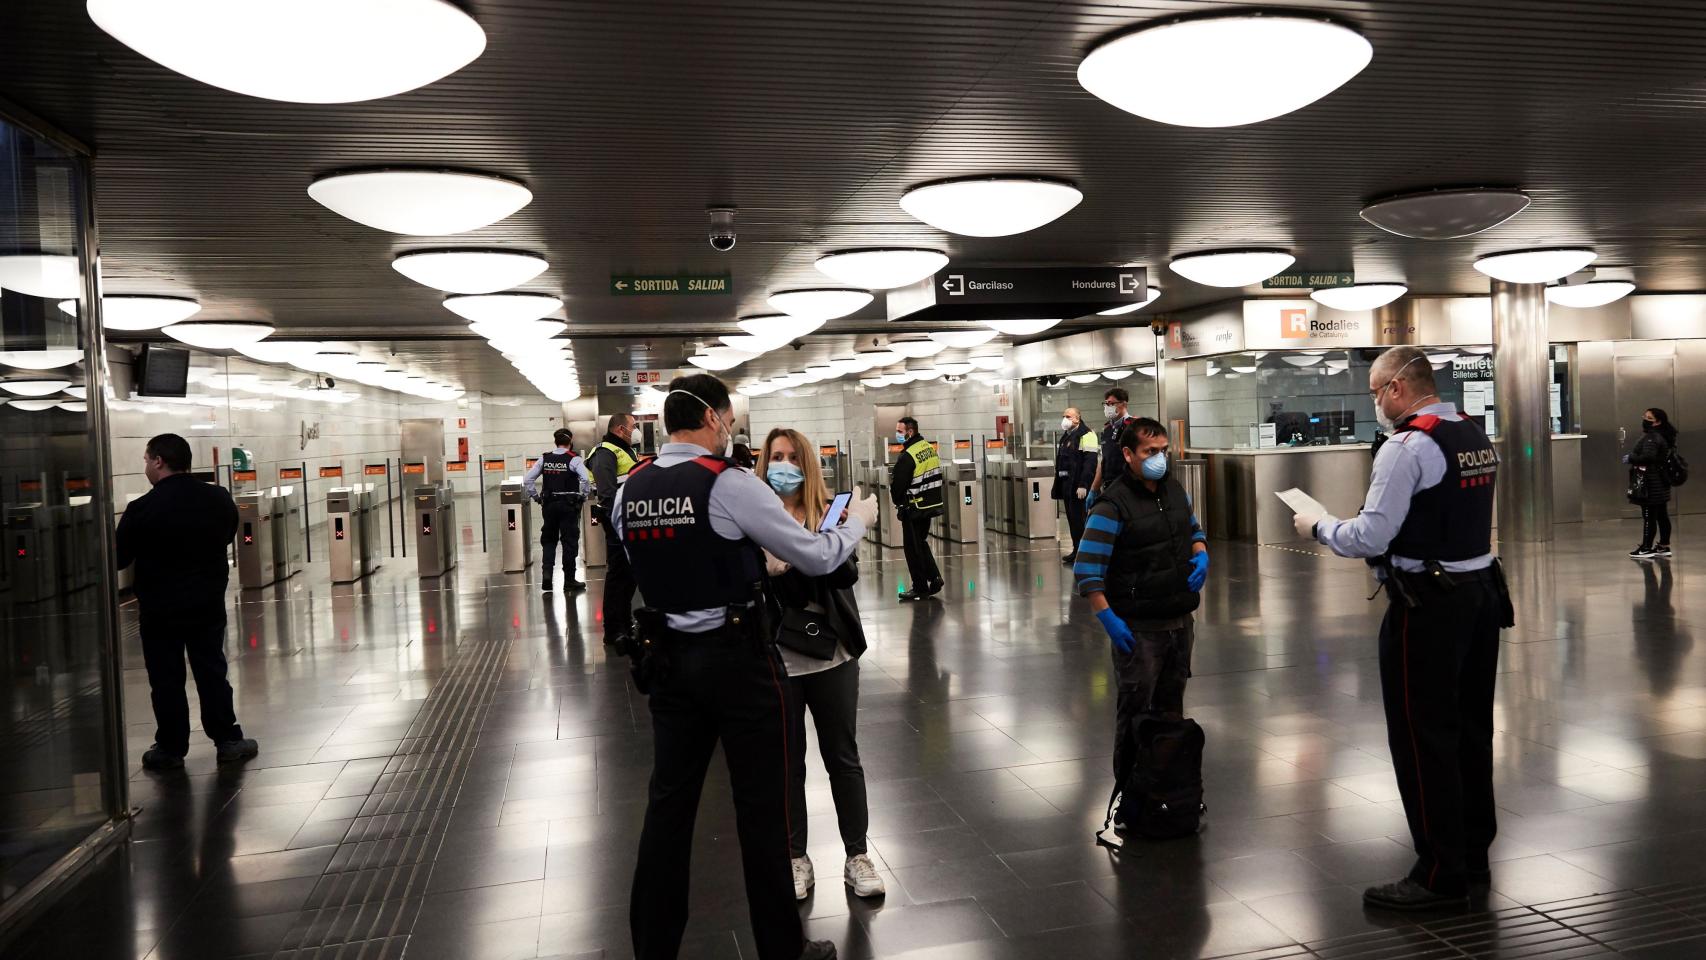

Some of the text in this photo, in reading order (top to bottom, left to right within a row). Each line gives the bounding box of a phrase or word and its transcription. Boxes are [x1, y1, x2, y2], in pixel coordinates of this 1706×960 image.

[634, 279, 725, 291] SORTIDA SALIDA
[968, 280, 1014, 290] Garcilaso
[1072, 279, 1116, 289] Hondures
[1268, 275, 1337, 286] SORTIDA SALIDA
[1290, 313, 1307, 332] R
[1310, 319, 1360, 331] Rodalies
[1452, 370, 1494, 379] Billetes Tick
[1457, 448, 1496, 468] POLICIA
[626, 496, 694, 518] POLICIA
